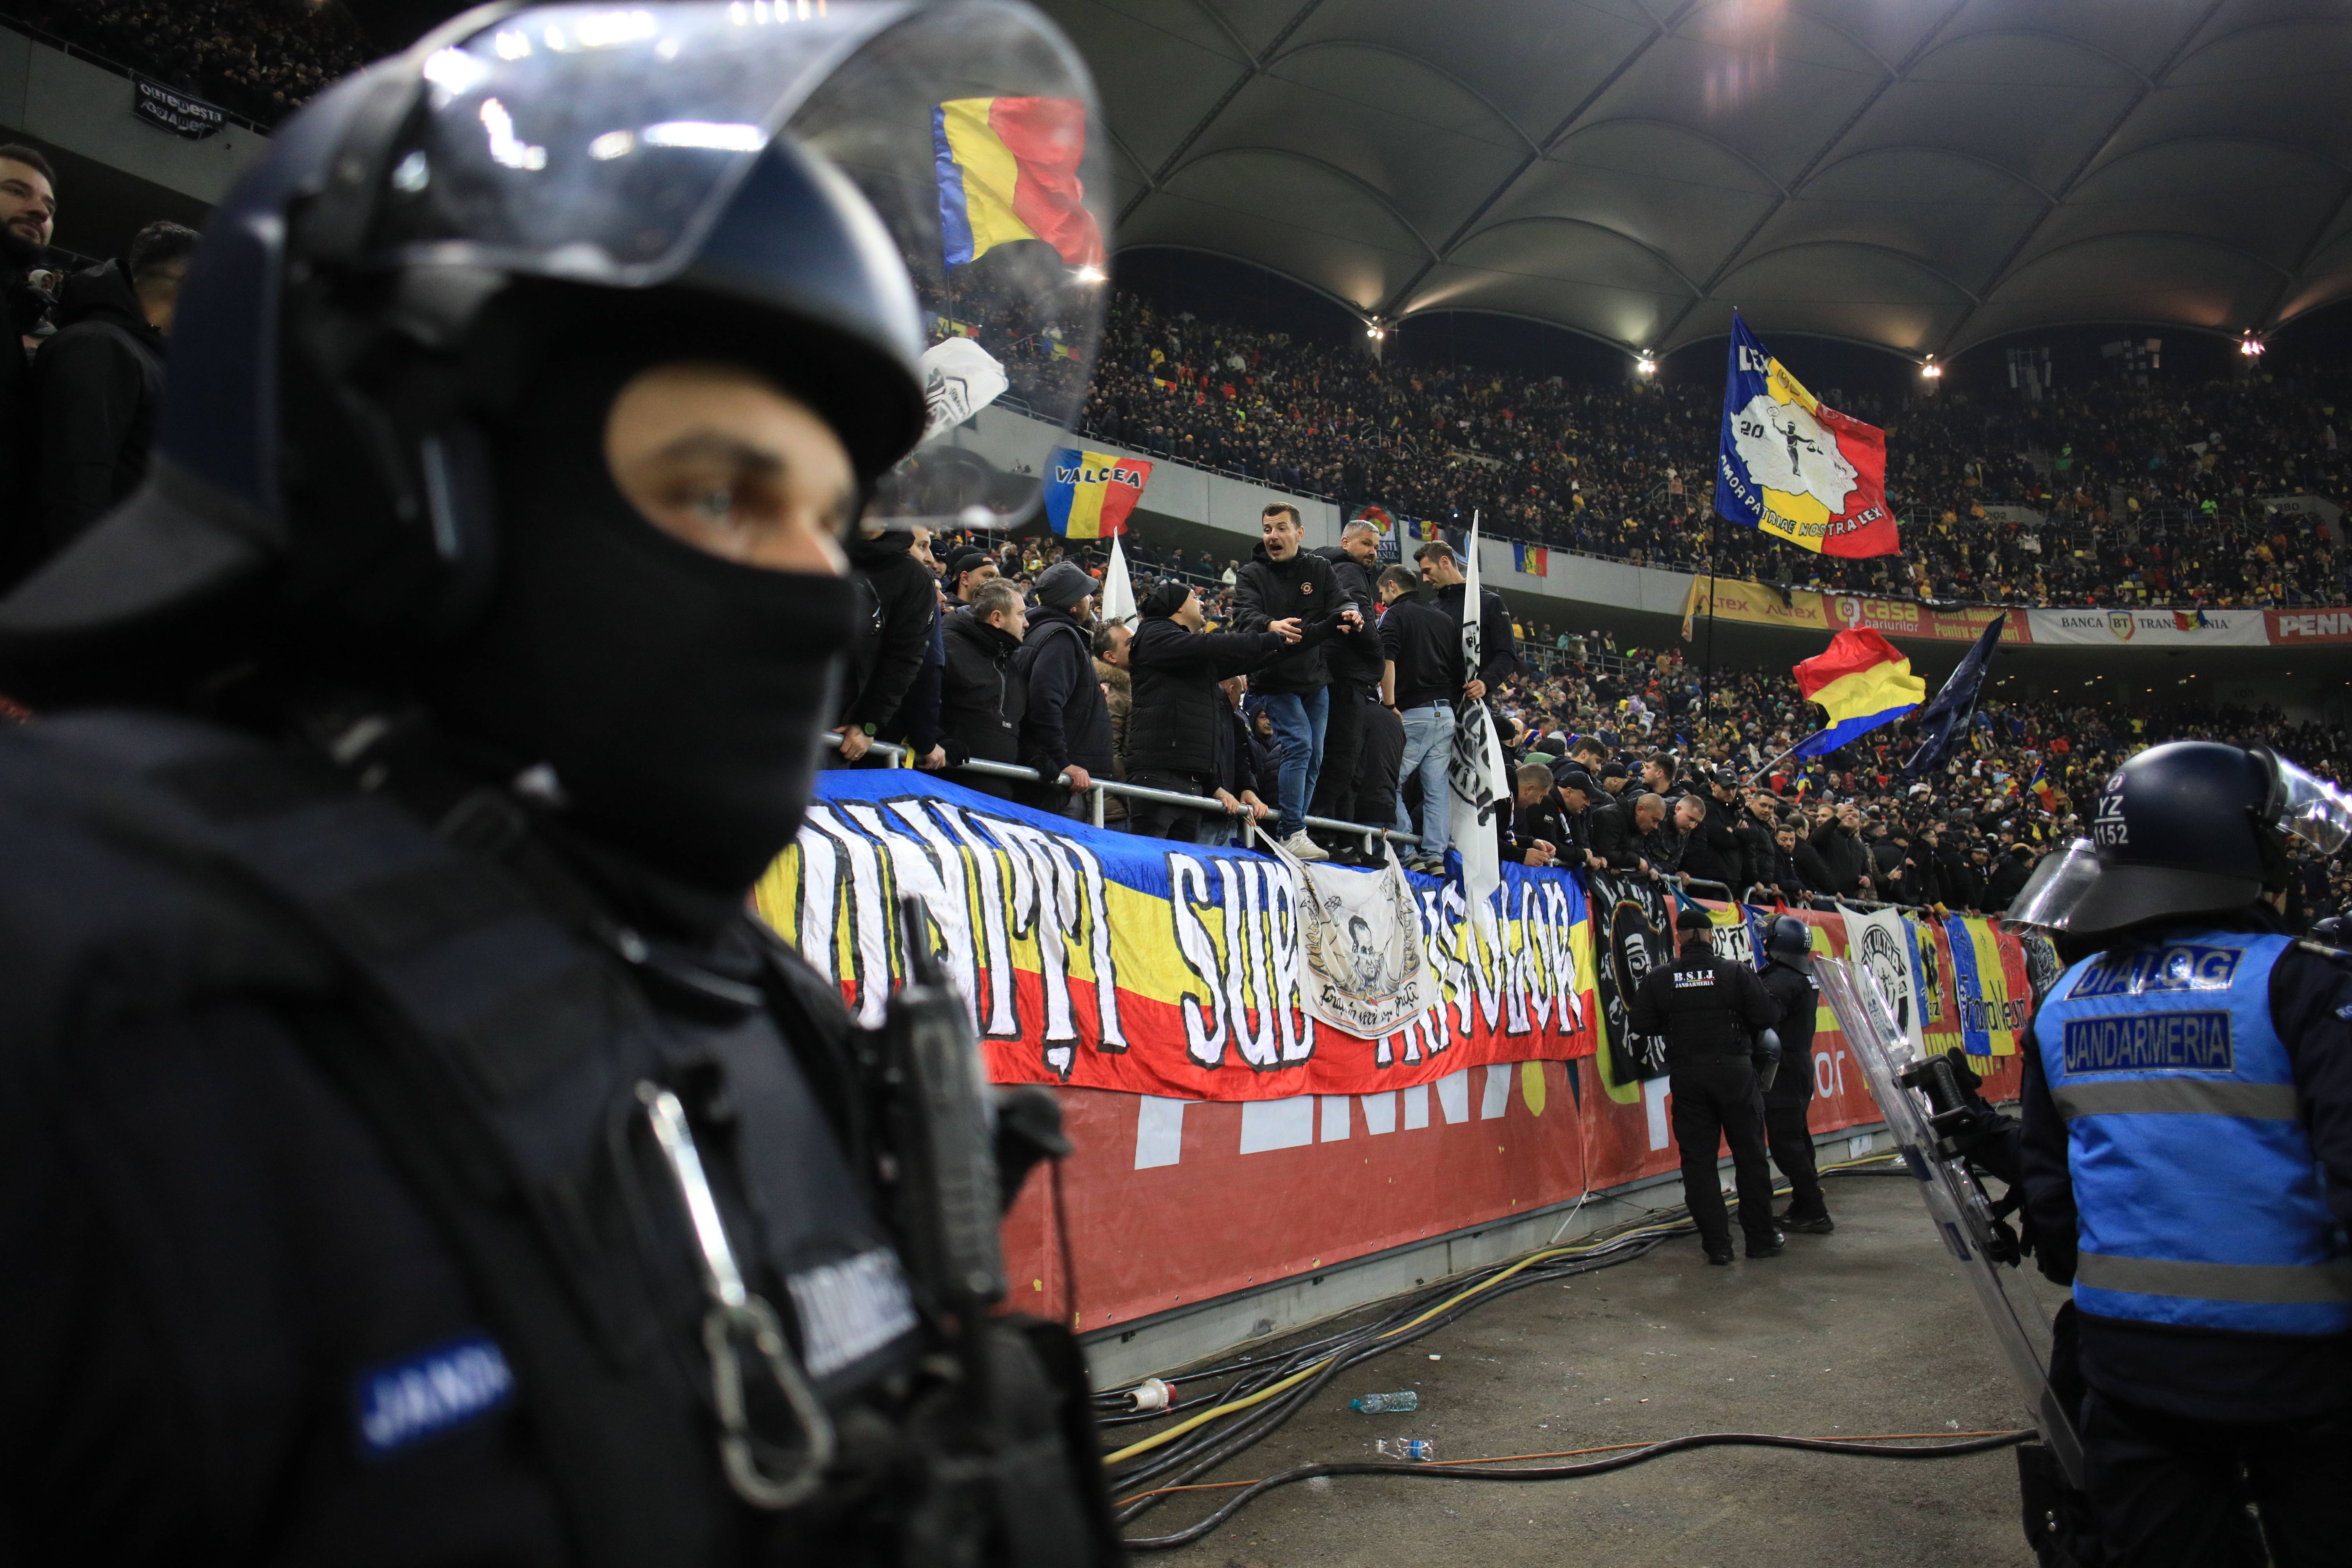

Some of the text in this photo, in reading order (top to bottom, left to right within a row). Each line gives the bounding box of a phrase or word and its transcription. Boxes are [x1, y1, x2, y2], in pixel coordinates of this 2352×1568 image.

[1739, 345, 1773, 377] LEX
[1740, 421, 1764, 439] 20
[1055, 466, 1141, 489] VALCEA
[1744, 495, 1797, 534] PATRIAE
[1798, 518, 1858, 537] NOSTRA
[1857, 507, 1883, 526] LEX
[1377, 551, 1396, 559] ANIA
[1934, 622, 1970, 639] Pentru
[2061, 617, 2103, 628] BANCA
[2112, 618, 2128, 628] BT
[2138, 618, 2229, 629] TRANSNIA
[2098, 796, 2123, 815] YZ
[2094, 824, 2129, 845] 1152
[1164, 851, 1316, 1073] SUB
[1374, 874, 1587, 1070] ICOLOR
[2078, 946, 2233, 996] DIALOG
[1673, 969, 1715, 982] B.S.I.J.
[2067, 1017, 2230, 1069] JANDARMERIA
